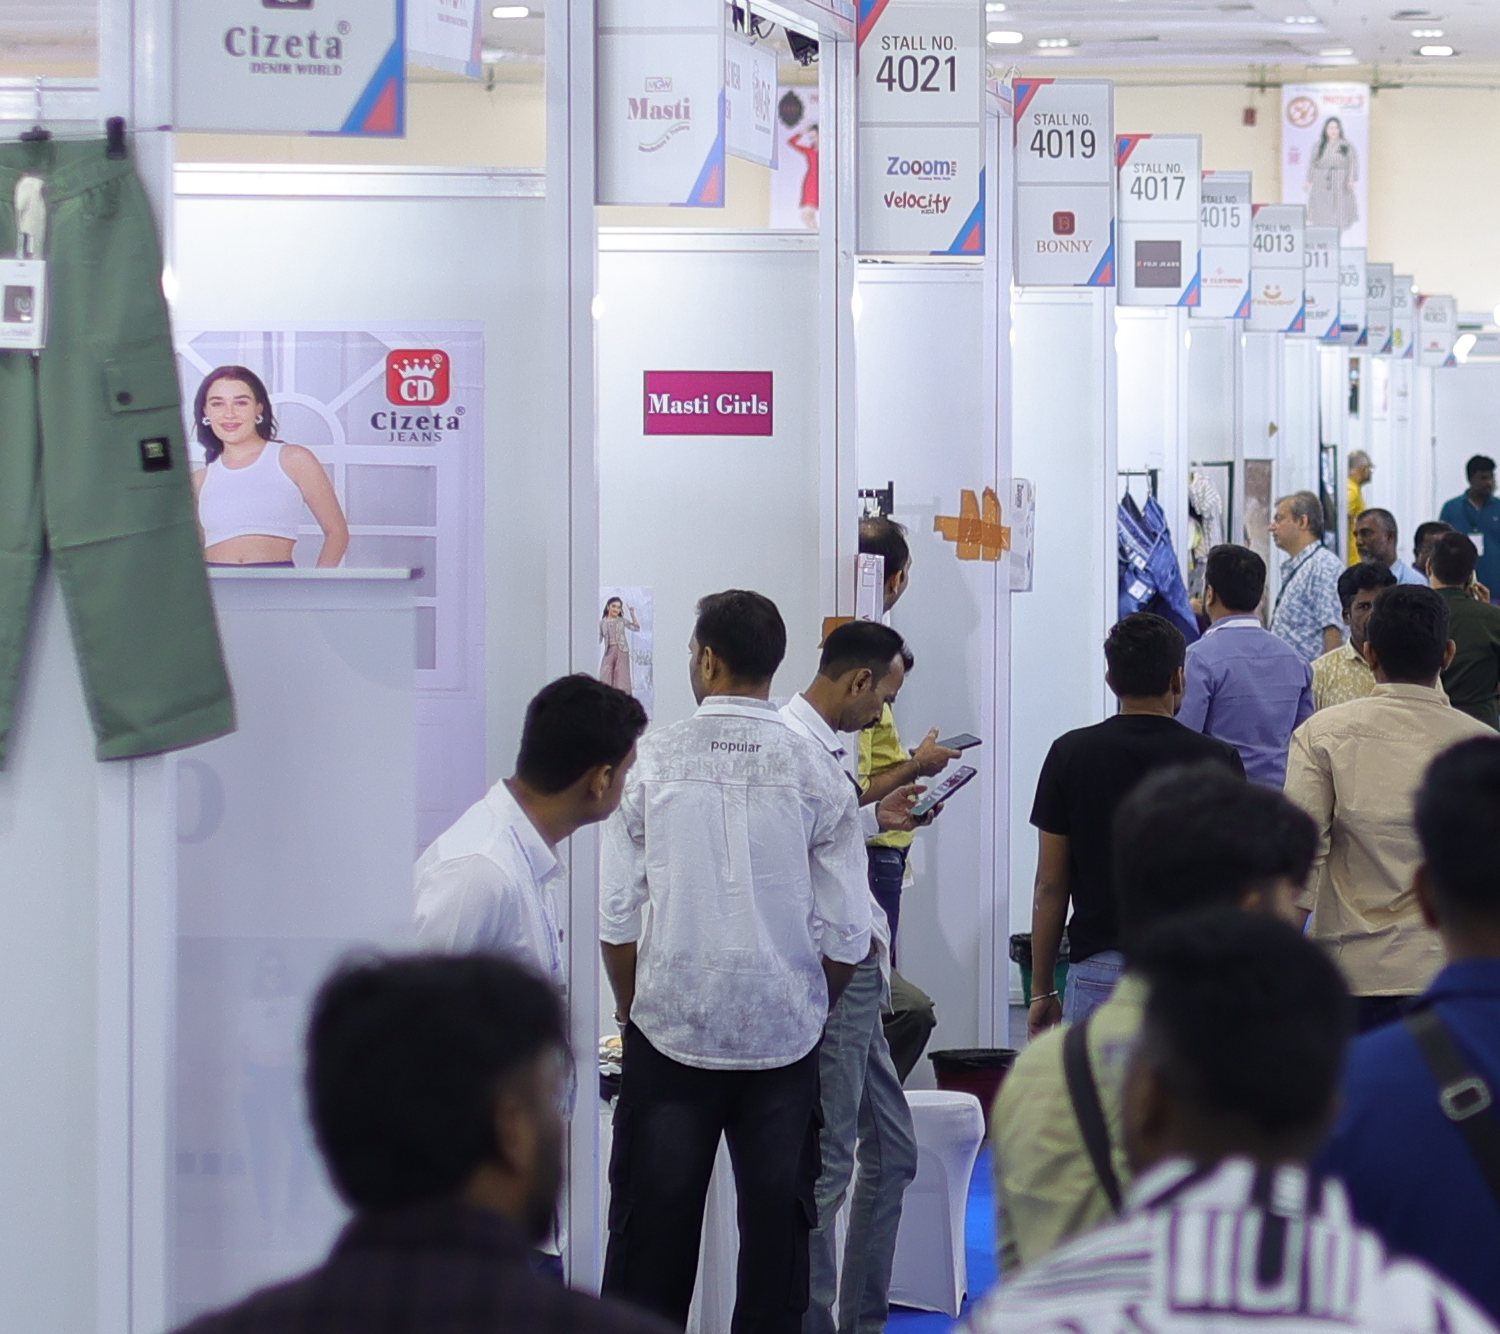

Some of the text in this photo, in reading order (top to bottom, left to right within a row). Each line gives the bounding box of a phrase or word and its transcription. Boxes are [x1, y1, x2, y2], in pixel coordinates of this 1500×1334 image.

[881, 35, 958, 51] STALL NO.
[876, 55, 956, 93] 4021
[627, 96, 692, 121] Masti
[1034, 113, 1092, 126] STALL NO.
[1030, 128, 1096, 159] 4019
[886, 156, 951, 176] Zooom
[1133, 163, 1183, 174] STALL NO.
[1130, 176, 1186, 201] 4017
[883, 191, 952, 215] Velocity
[1201, 206, 1241, 228] 4015
[1036, 239, 1093, 254] BONNY
[1252, 234, 1295, 253] 4013
[400, 378, 435, 402] CD
[647, 393, 769, 415] Masti Girls
[388, 431, 443, 443] JEANS
[710, 740, 762, 754] popular
